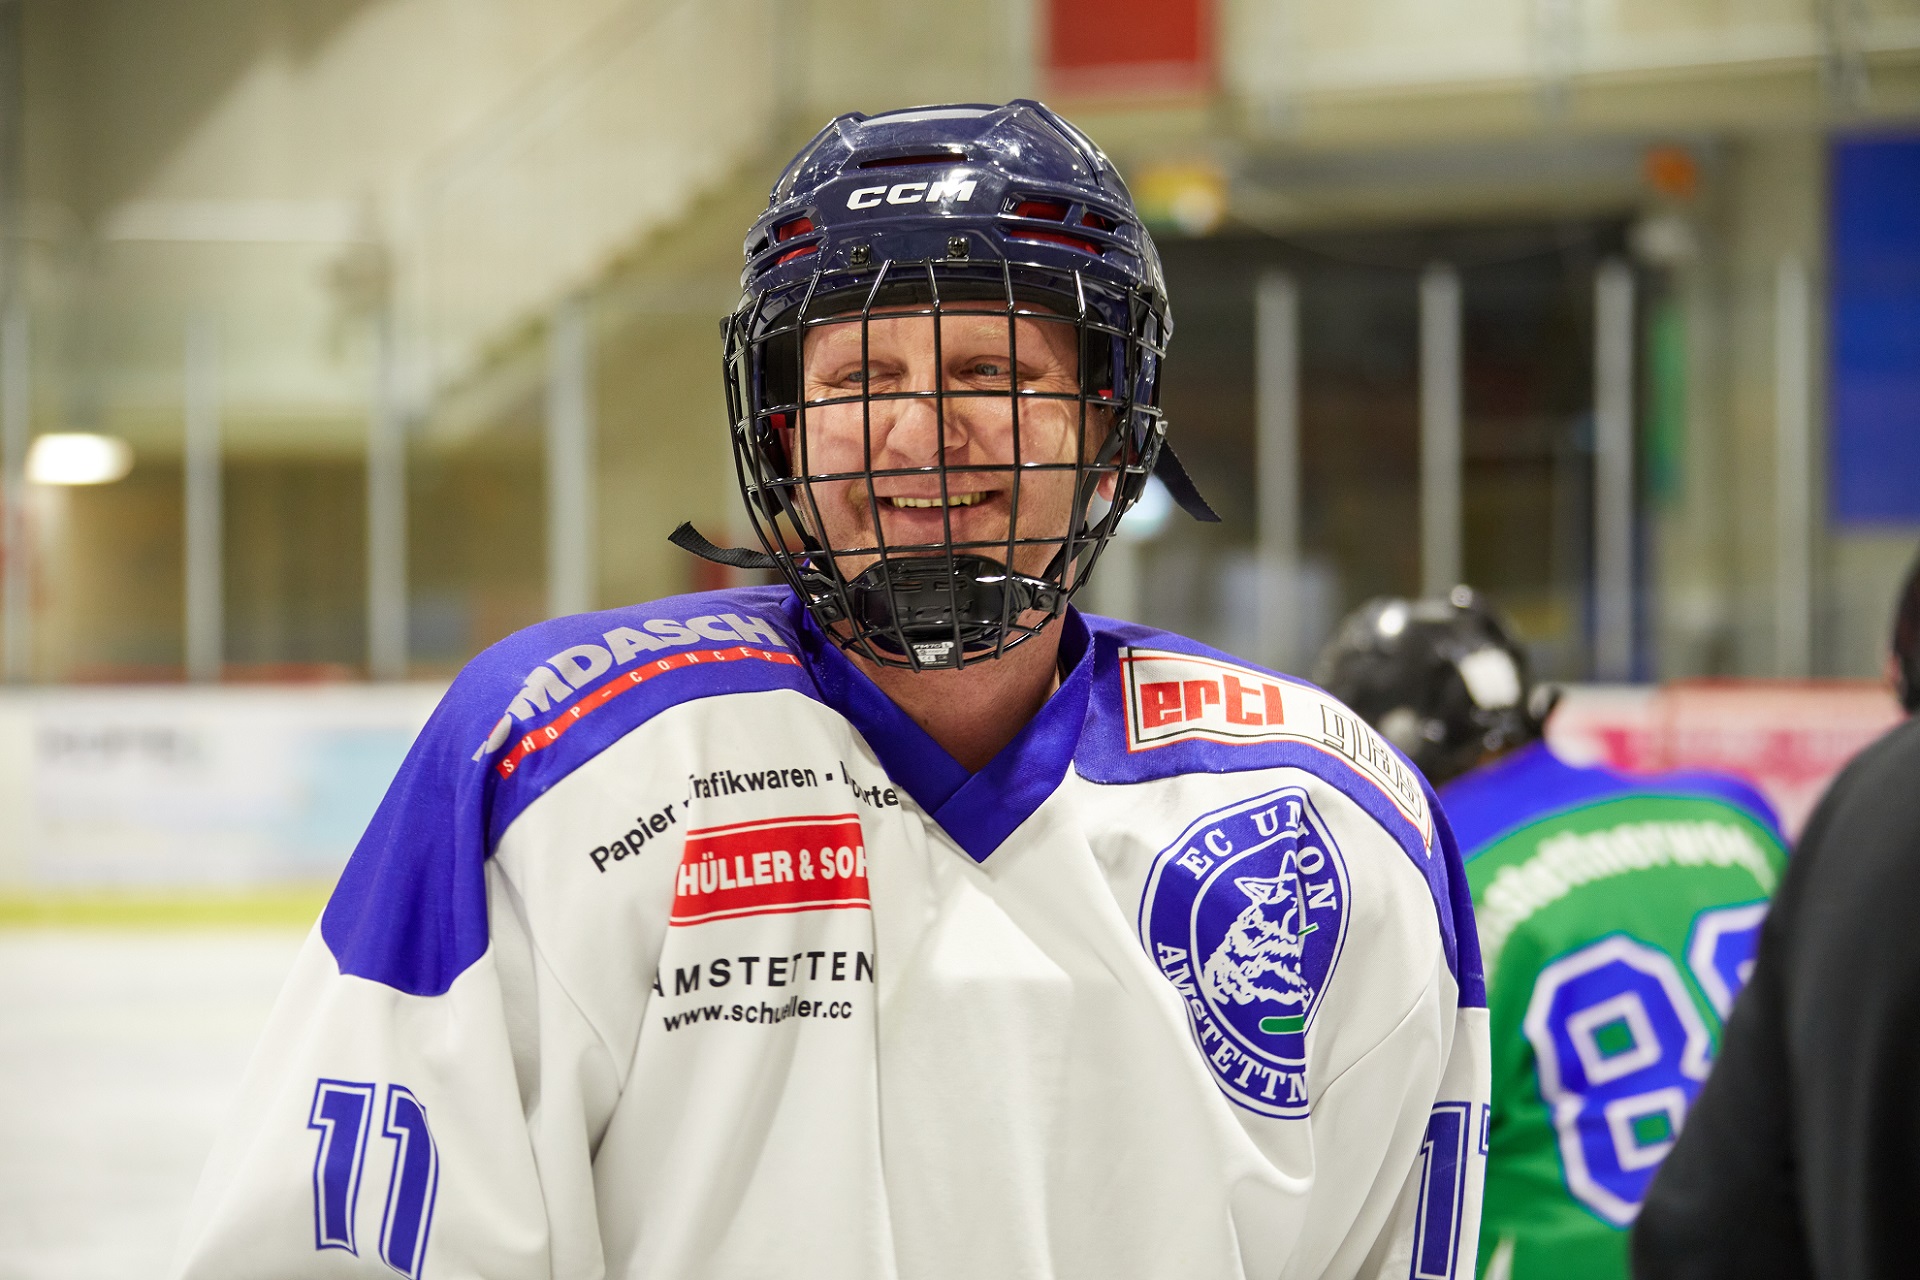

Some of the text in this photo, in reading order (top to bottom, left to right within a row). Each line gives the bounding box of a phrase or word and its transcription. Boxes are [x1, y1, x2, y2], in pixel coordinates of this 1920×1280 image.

[846, 181, 977, 210] CCM
[1140, 674, 1285, 729] ertl
[589, 802, 677, 873] Papier
[1176, 828, 1232, 880] EC
[799, 849, 815, 881] &
[307, 1078, 439, 1280] 11
